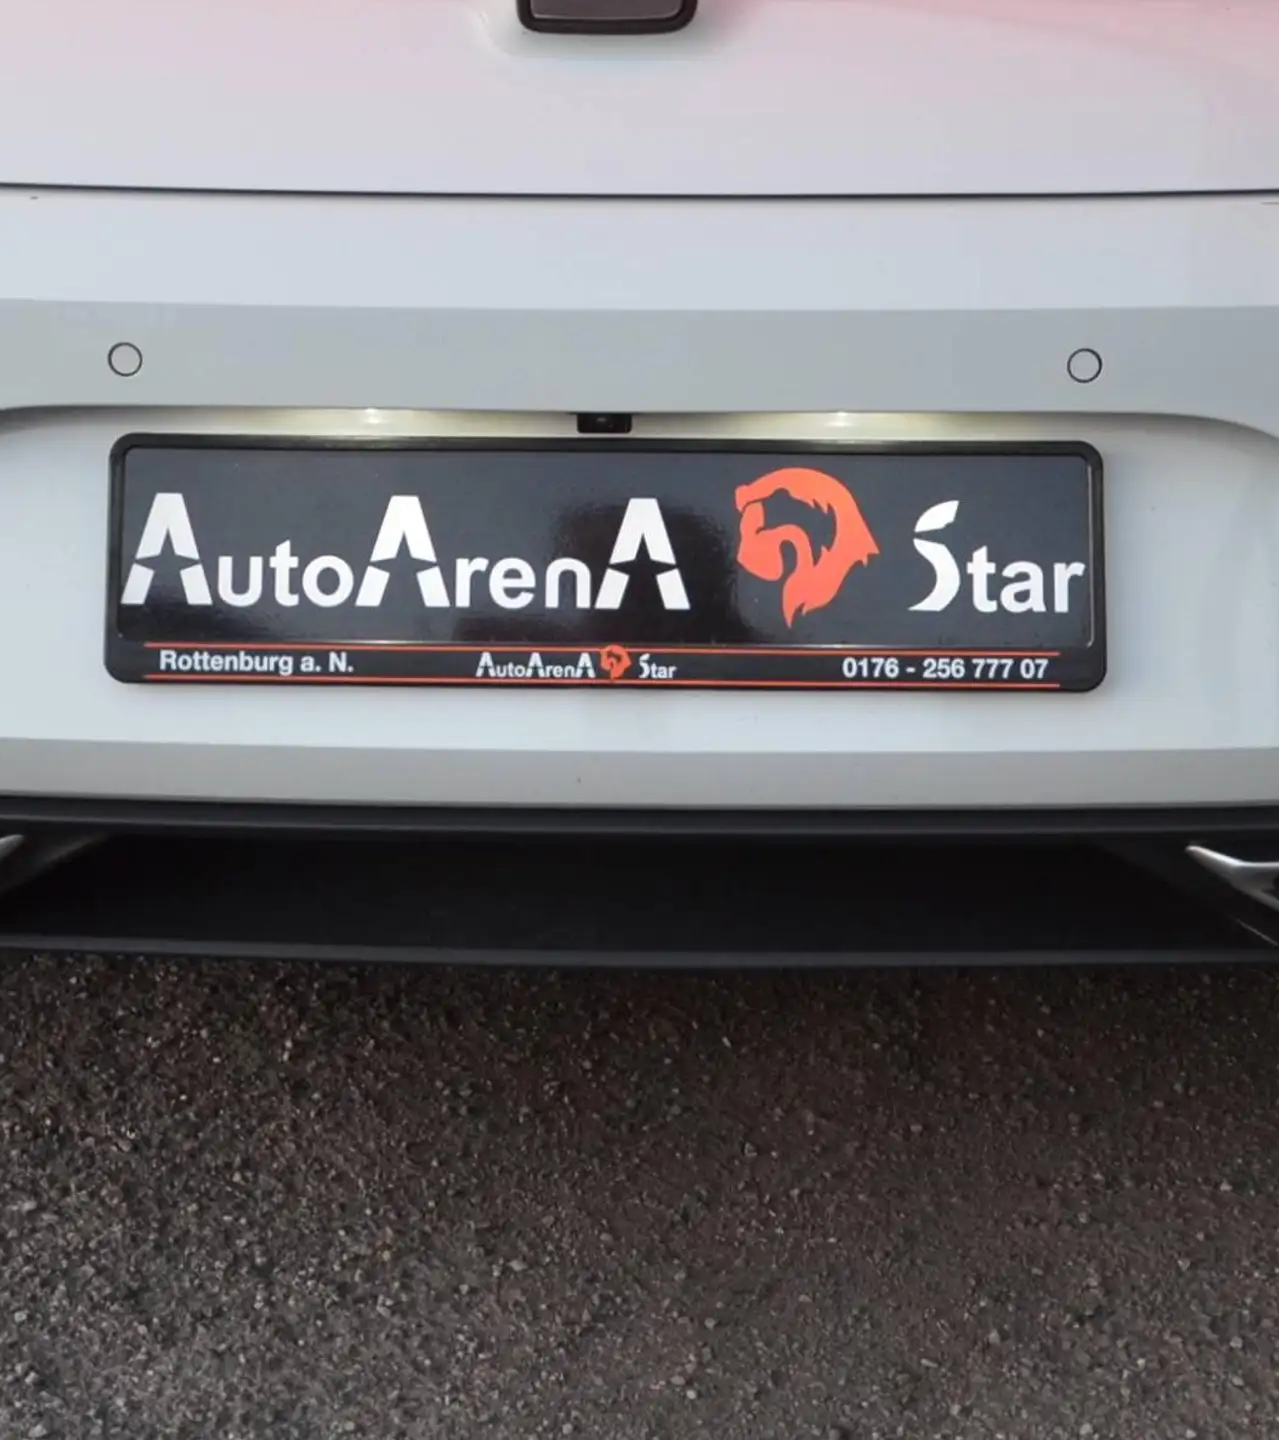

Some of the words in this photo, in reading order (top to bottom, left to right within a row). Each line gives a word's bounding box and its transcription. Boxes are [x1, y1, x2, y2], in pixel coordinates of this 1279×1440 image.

[120, 492, 691, 611] AutoArenA
[907, 499, 1086, 614] Star
[159, 649, 294, 676] Rottenburg
[300, 654, 322, 672] a.
[328, 652, 355, 673] N.
[637, 653, 677, 680] Star
[841, 657, 900, 679] 0176
[922, 658, 966, 679] 256
[972, 658, 1013, 680] 777
[1019, 658, 1049, 680] 07
